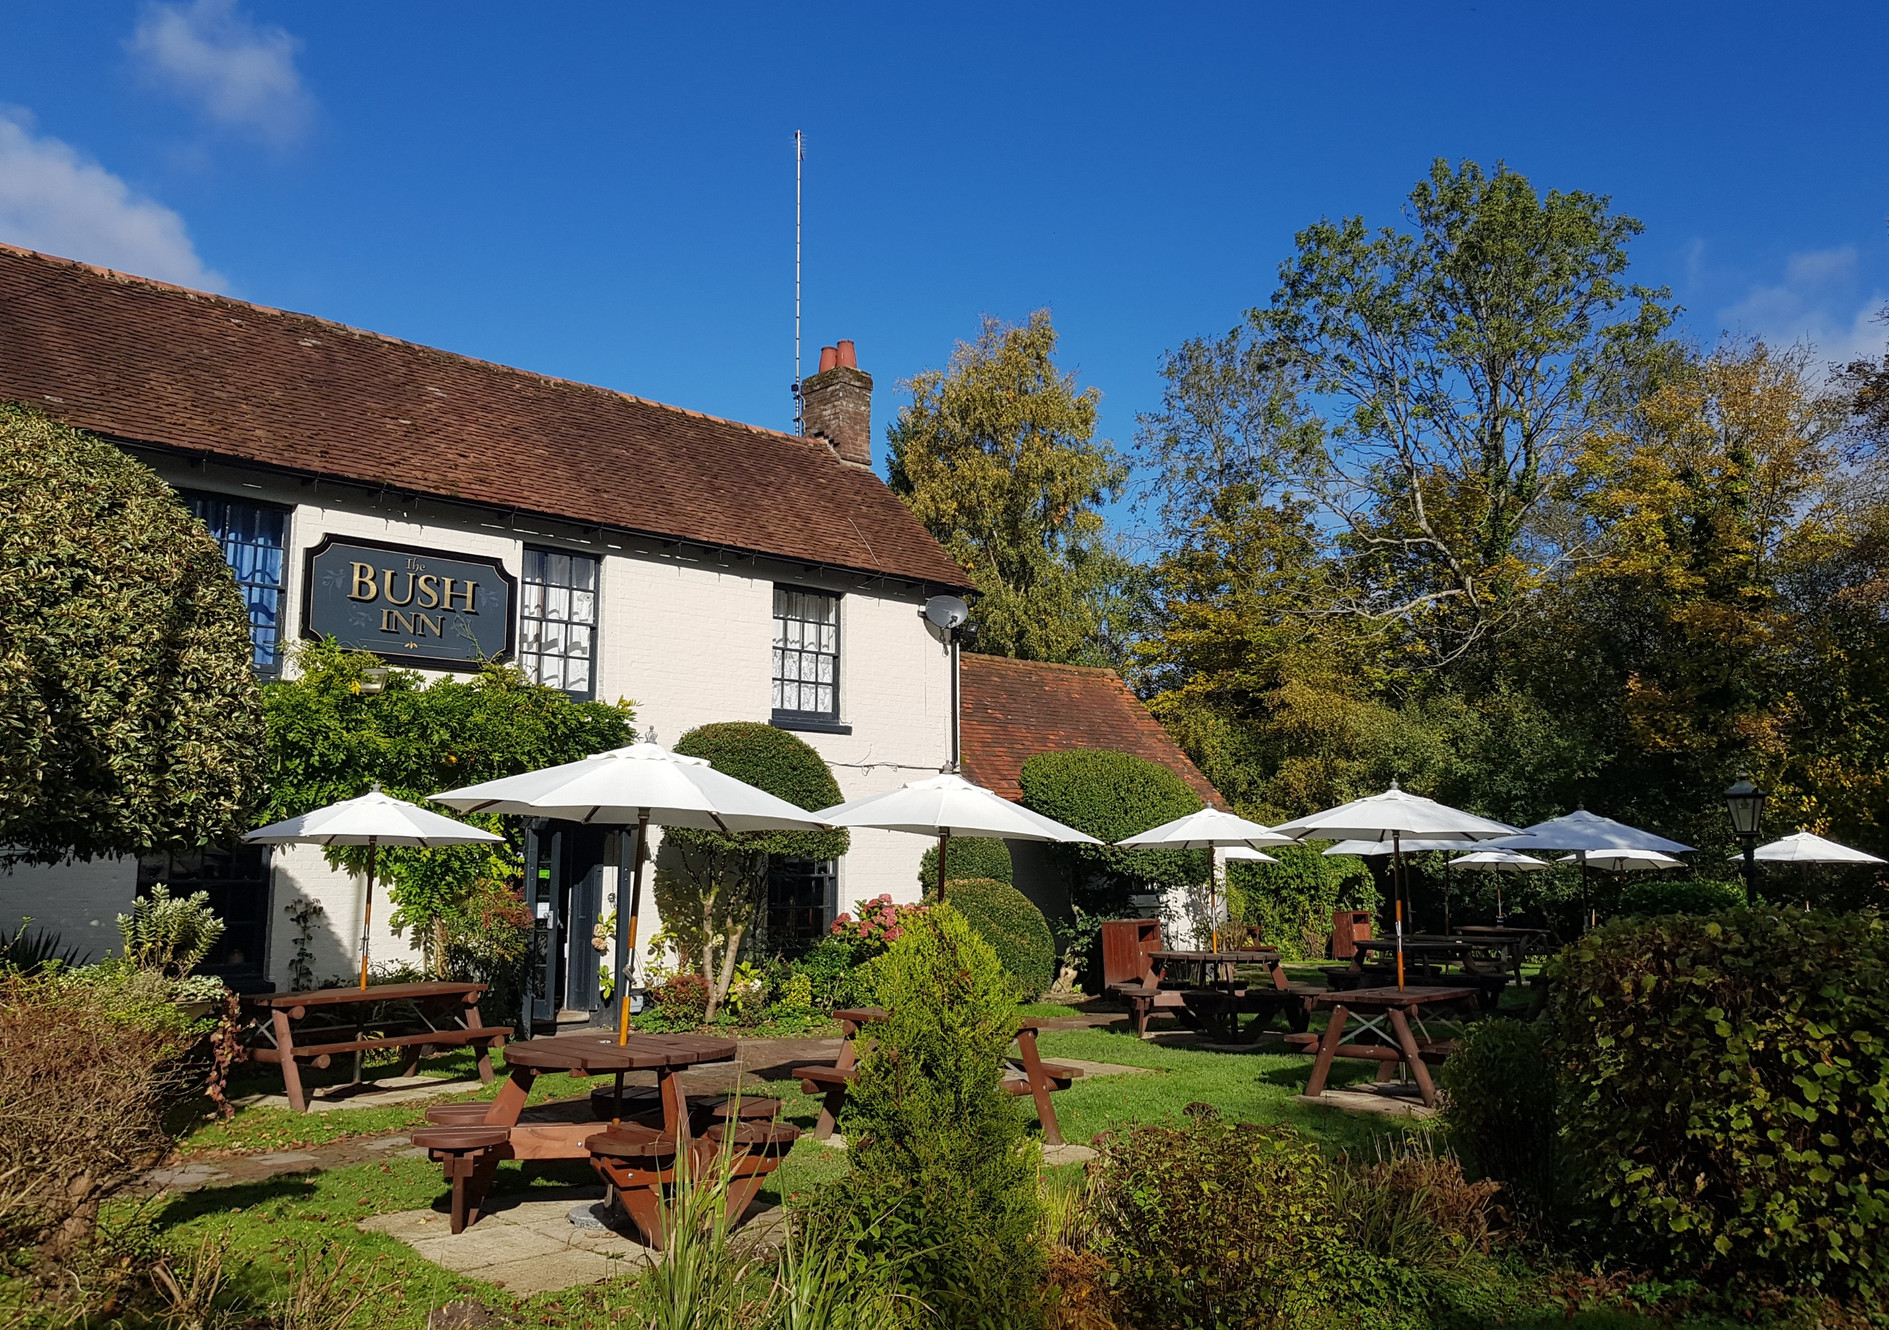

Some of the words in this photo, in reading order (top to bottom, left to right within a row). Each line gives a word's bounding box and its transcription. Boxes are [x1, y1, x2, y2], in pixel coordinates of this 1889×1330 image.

[405, 558, 426, 572] The
[347, 561, 478, 613] BUSH
[378, 608, 445, 637] INN
